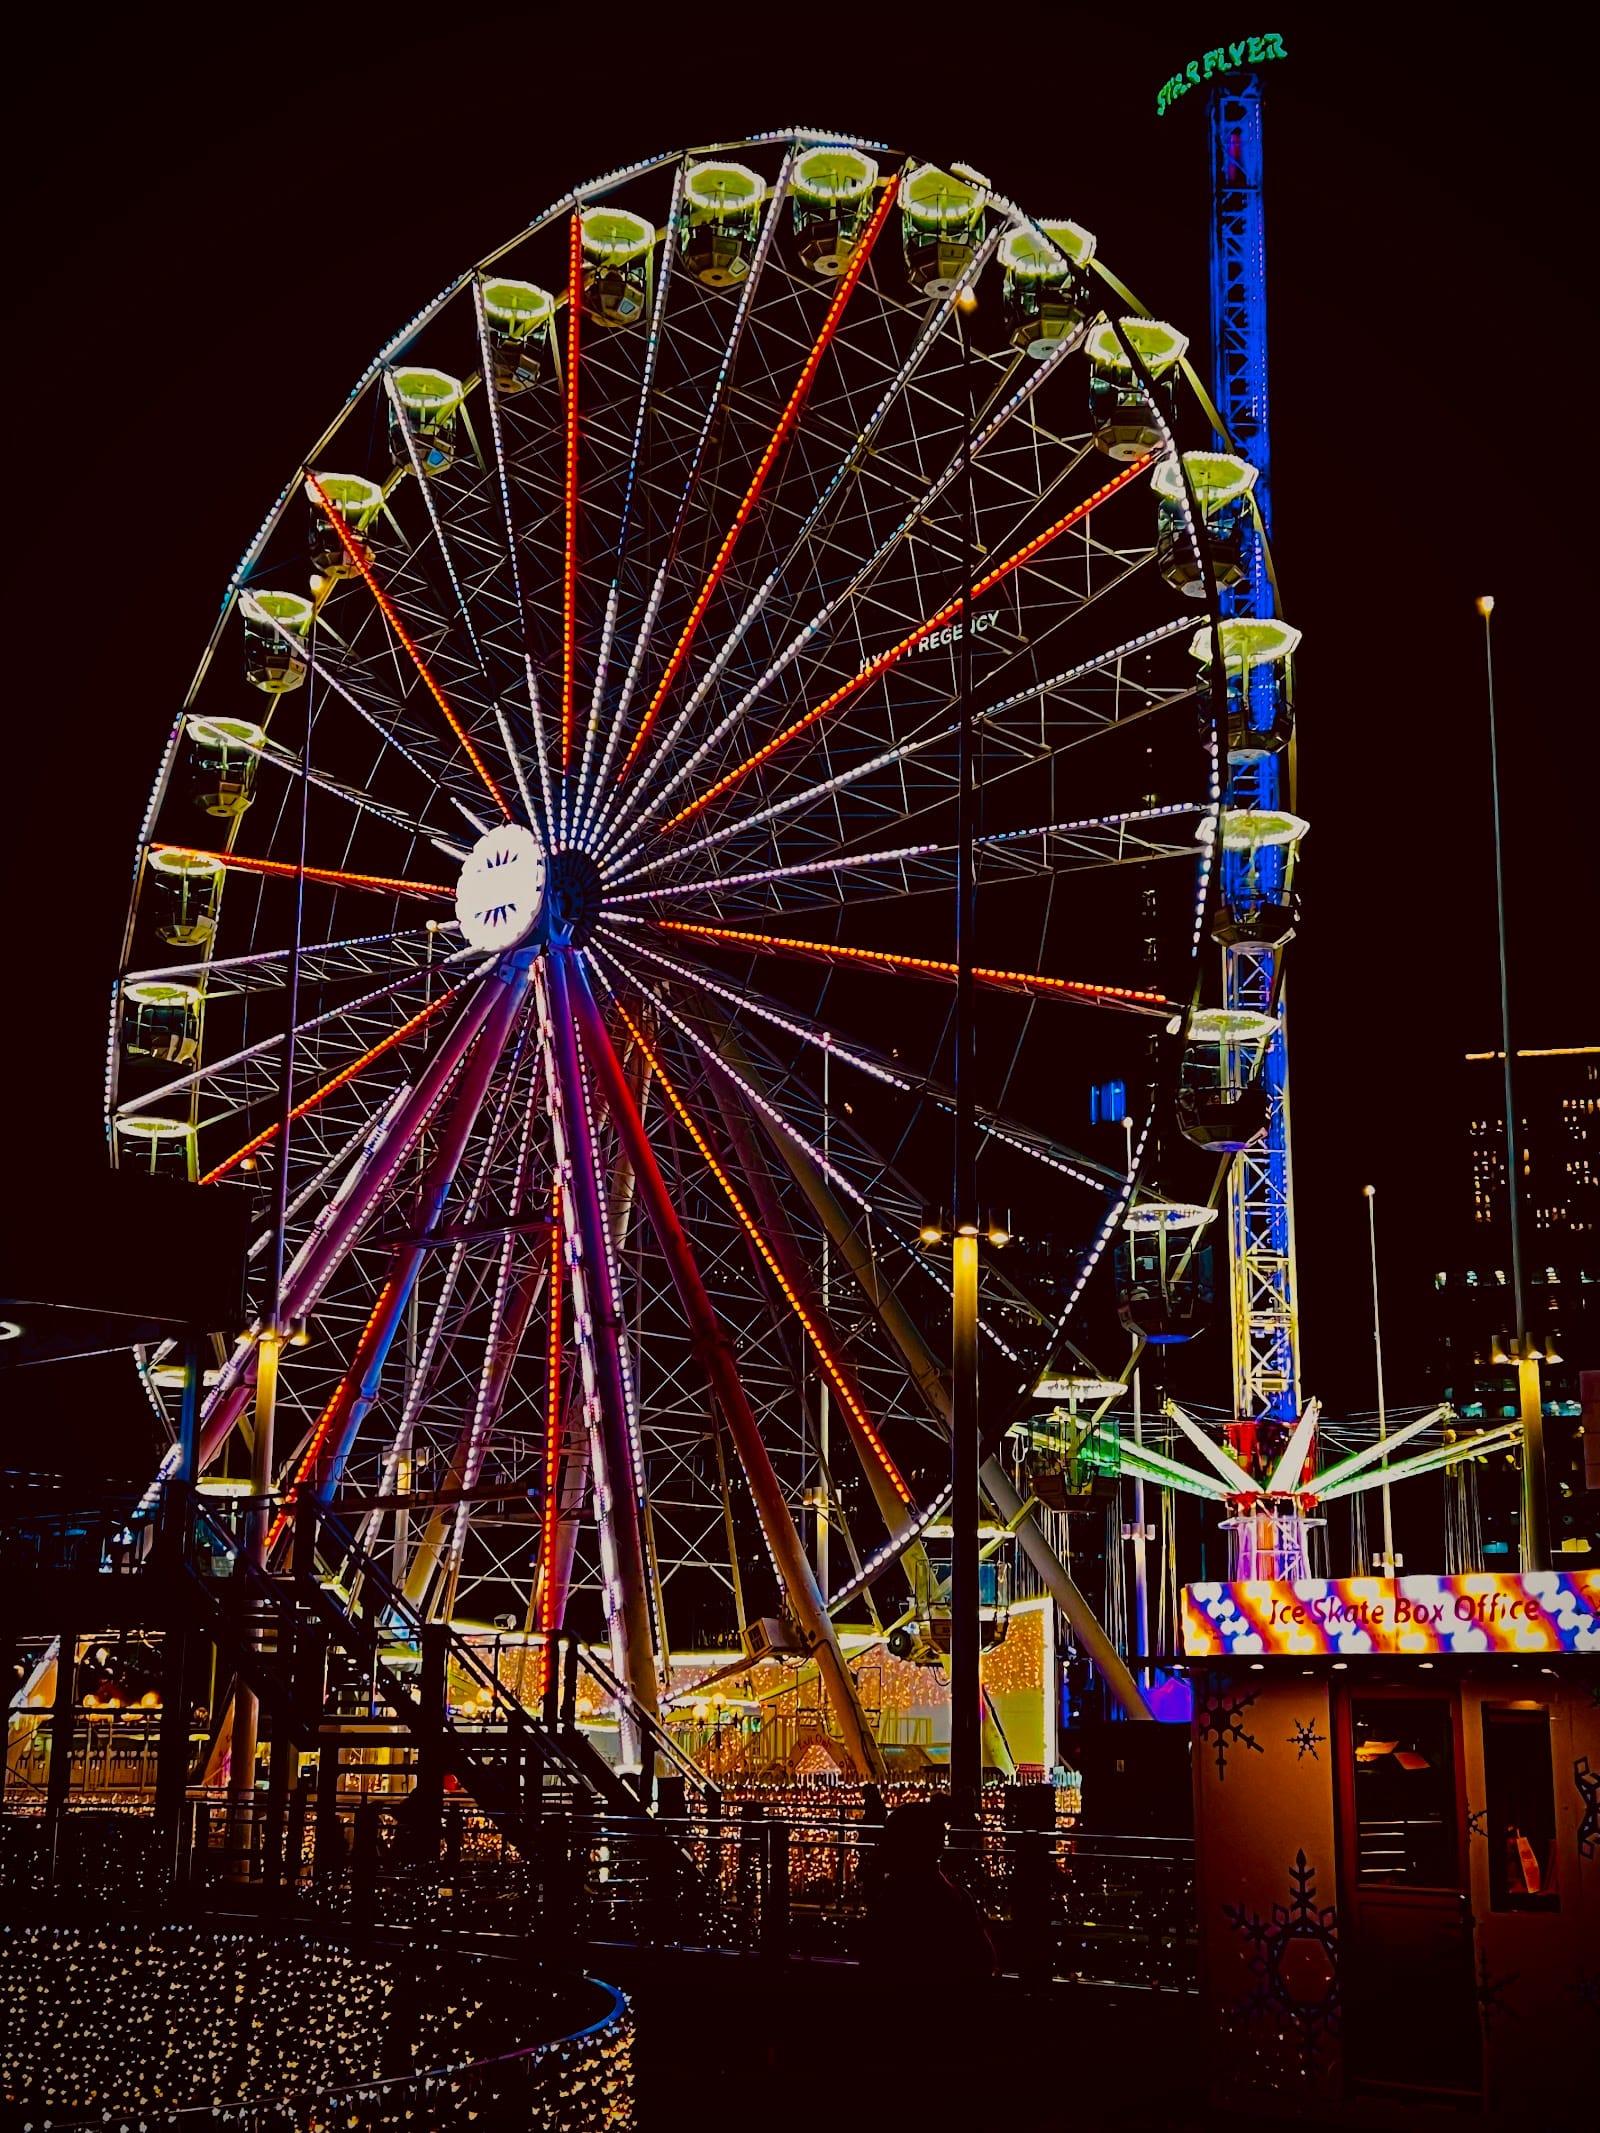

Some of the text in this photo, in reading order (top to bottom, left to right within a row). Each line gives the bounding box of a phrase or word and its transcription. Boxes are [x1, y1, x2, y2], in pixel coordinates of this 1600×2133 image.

[1157, 33, 1288, 116] STAR FLYER
[859, 644, 914, 676] HYA
[1269, 1593, 1539, 1625] Ice Skate Box Office
